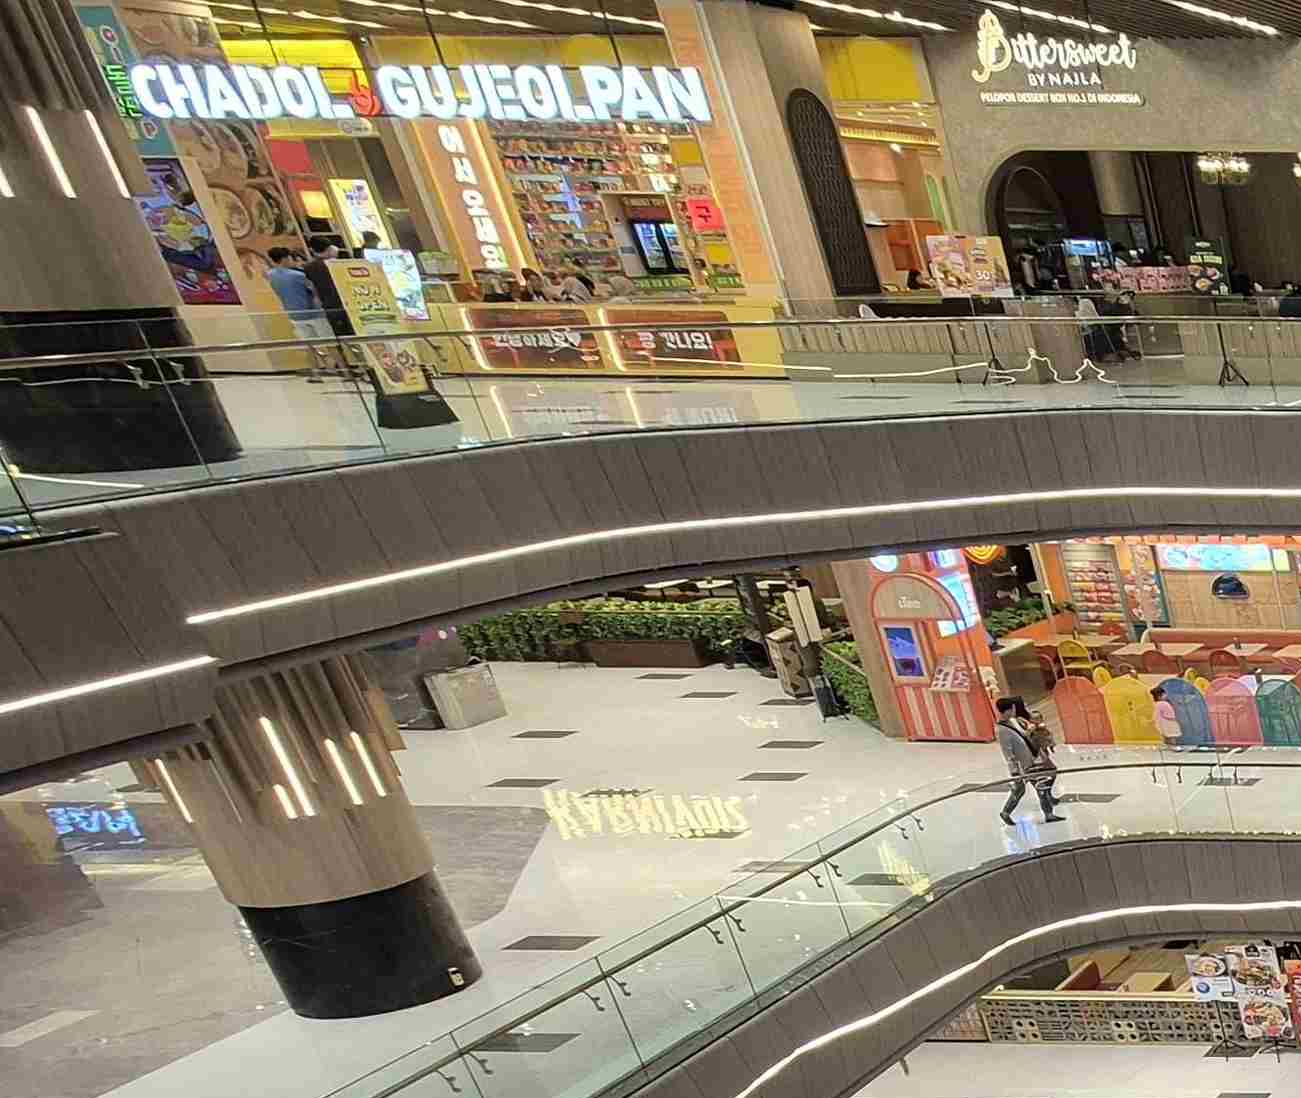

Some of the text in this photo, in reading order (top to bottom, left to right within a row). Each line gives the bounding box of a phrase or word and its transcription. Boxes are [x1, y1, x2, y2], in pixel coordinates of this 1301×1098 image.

[131, 64, 355, 119] CHADOL
[376, 64, 713, 122] GUJEOLPAN
[1028, 72, 1101, 87] BY NAJLA
